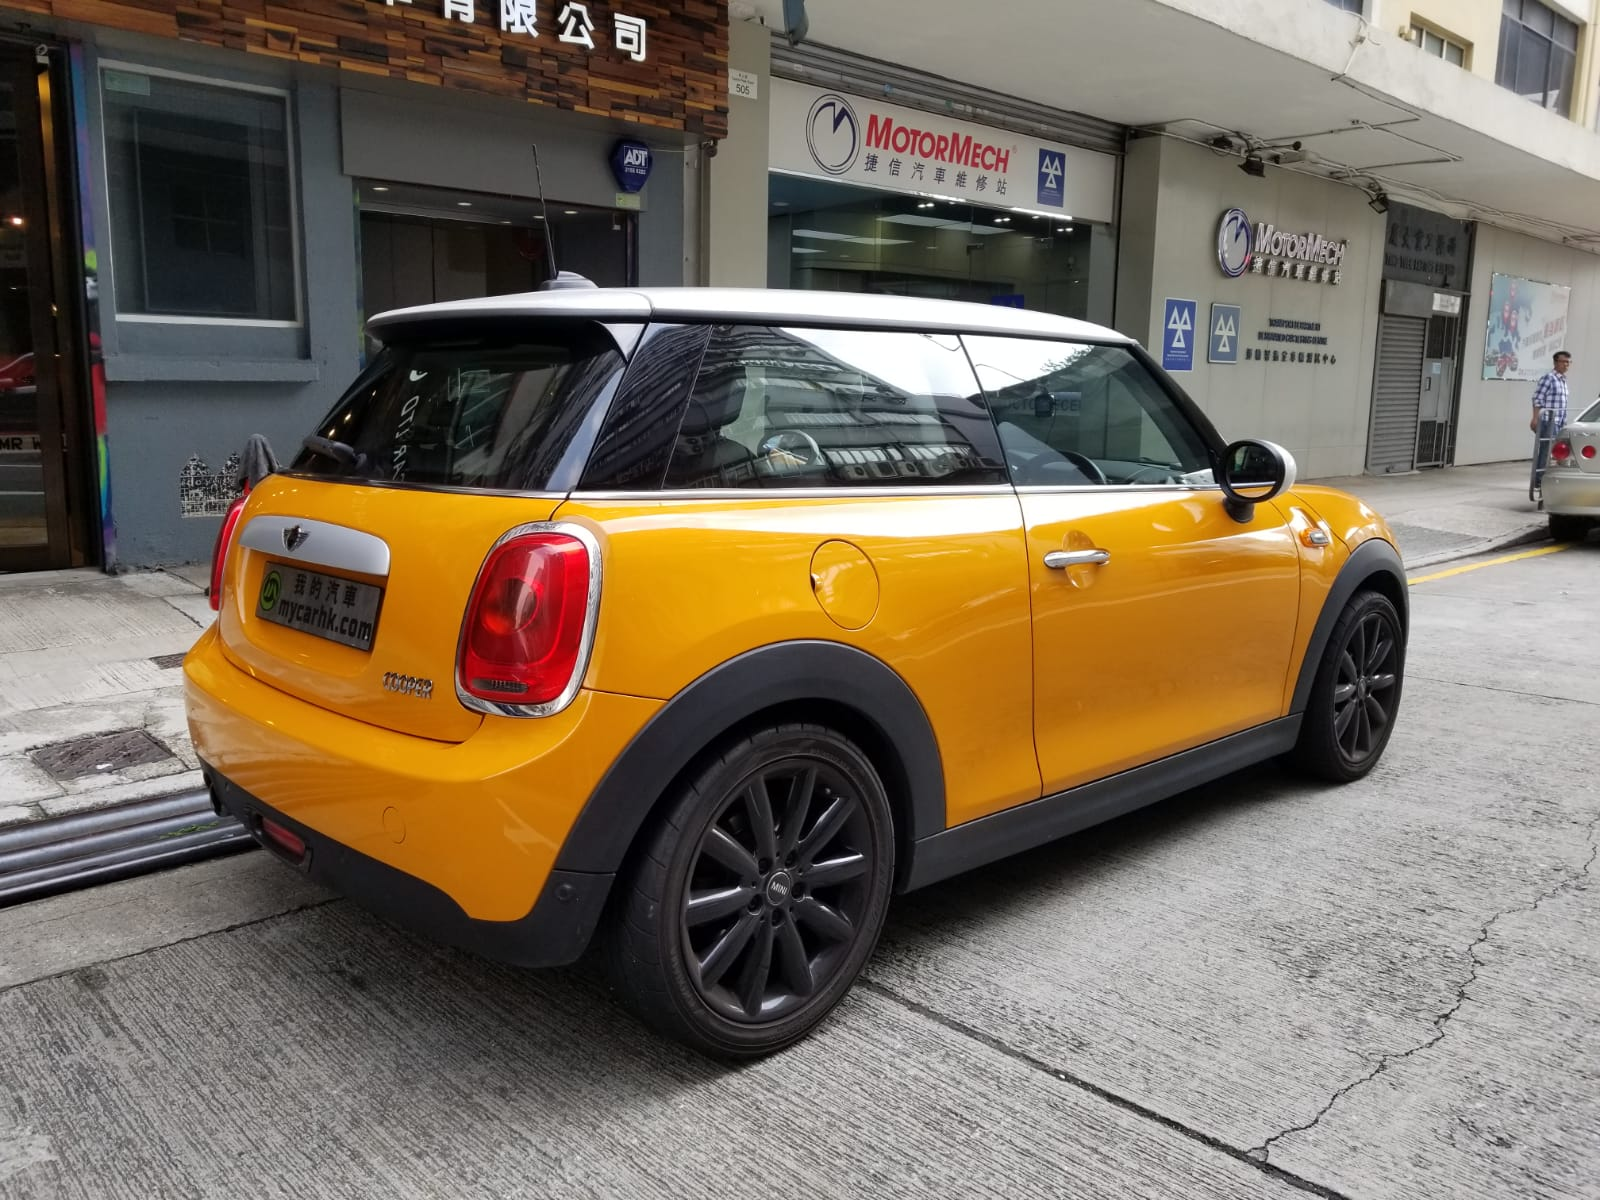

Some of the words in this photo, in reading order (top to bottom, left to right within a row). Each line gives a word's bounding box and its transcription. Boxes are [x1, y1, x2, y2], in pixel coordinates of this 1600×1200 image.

[386, 0, 646, 62] 限公司
[736, 83, 750, 95] 505
[624, 149, 648, 167] ADT
[864, 152, 1008, 196] 捷信汽車維修站
[293, 573, 358, 608] 我的汽車
[278, 599, 372, 641] mycarhk.com
[382, 671, 433, 699] COOPER
[771, 881, 788, 895] MINI
